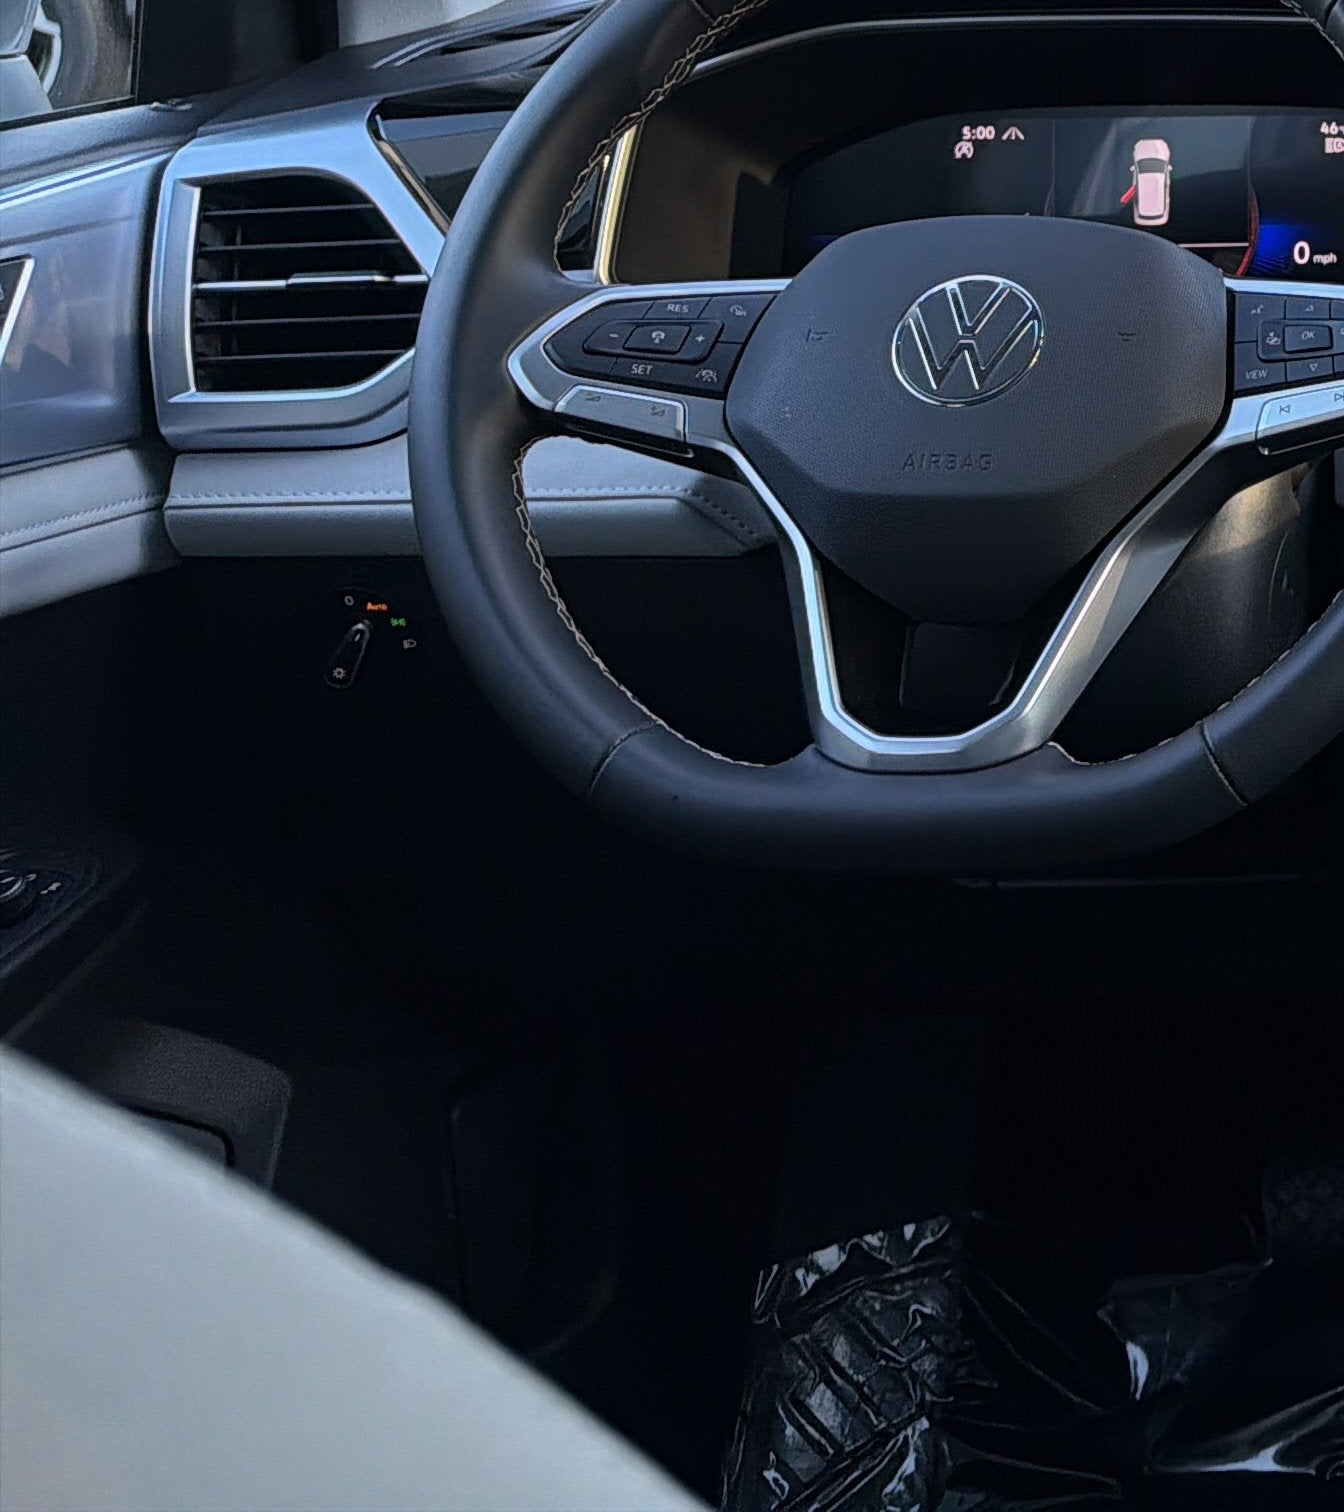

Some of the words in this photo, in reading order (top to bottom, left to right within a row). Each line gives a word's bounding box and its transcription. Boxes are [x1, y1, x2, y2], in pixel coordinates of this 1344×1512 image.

[962, 125, 996, 140] 5:00
[1293, 240, 1311, 265] 0
[1312, 252, 1338, 266] mph
[666, 303, 689, 313] RES
[1301, 330, 1315, 341] OK
[630, 363, 654, 375] SET
[1245, 369, 1269, 380] VIEW
[902, 453, 993, 471] AIRBAG
